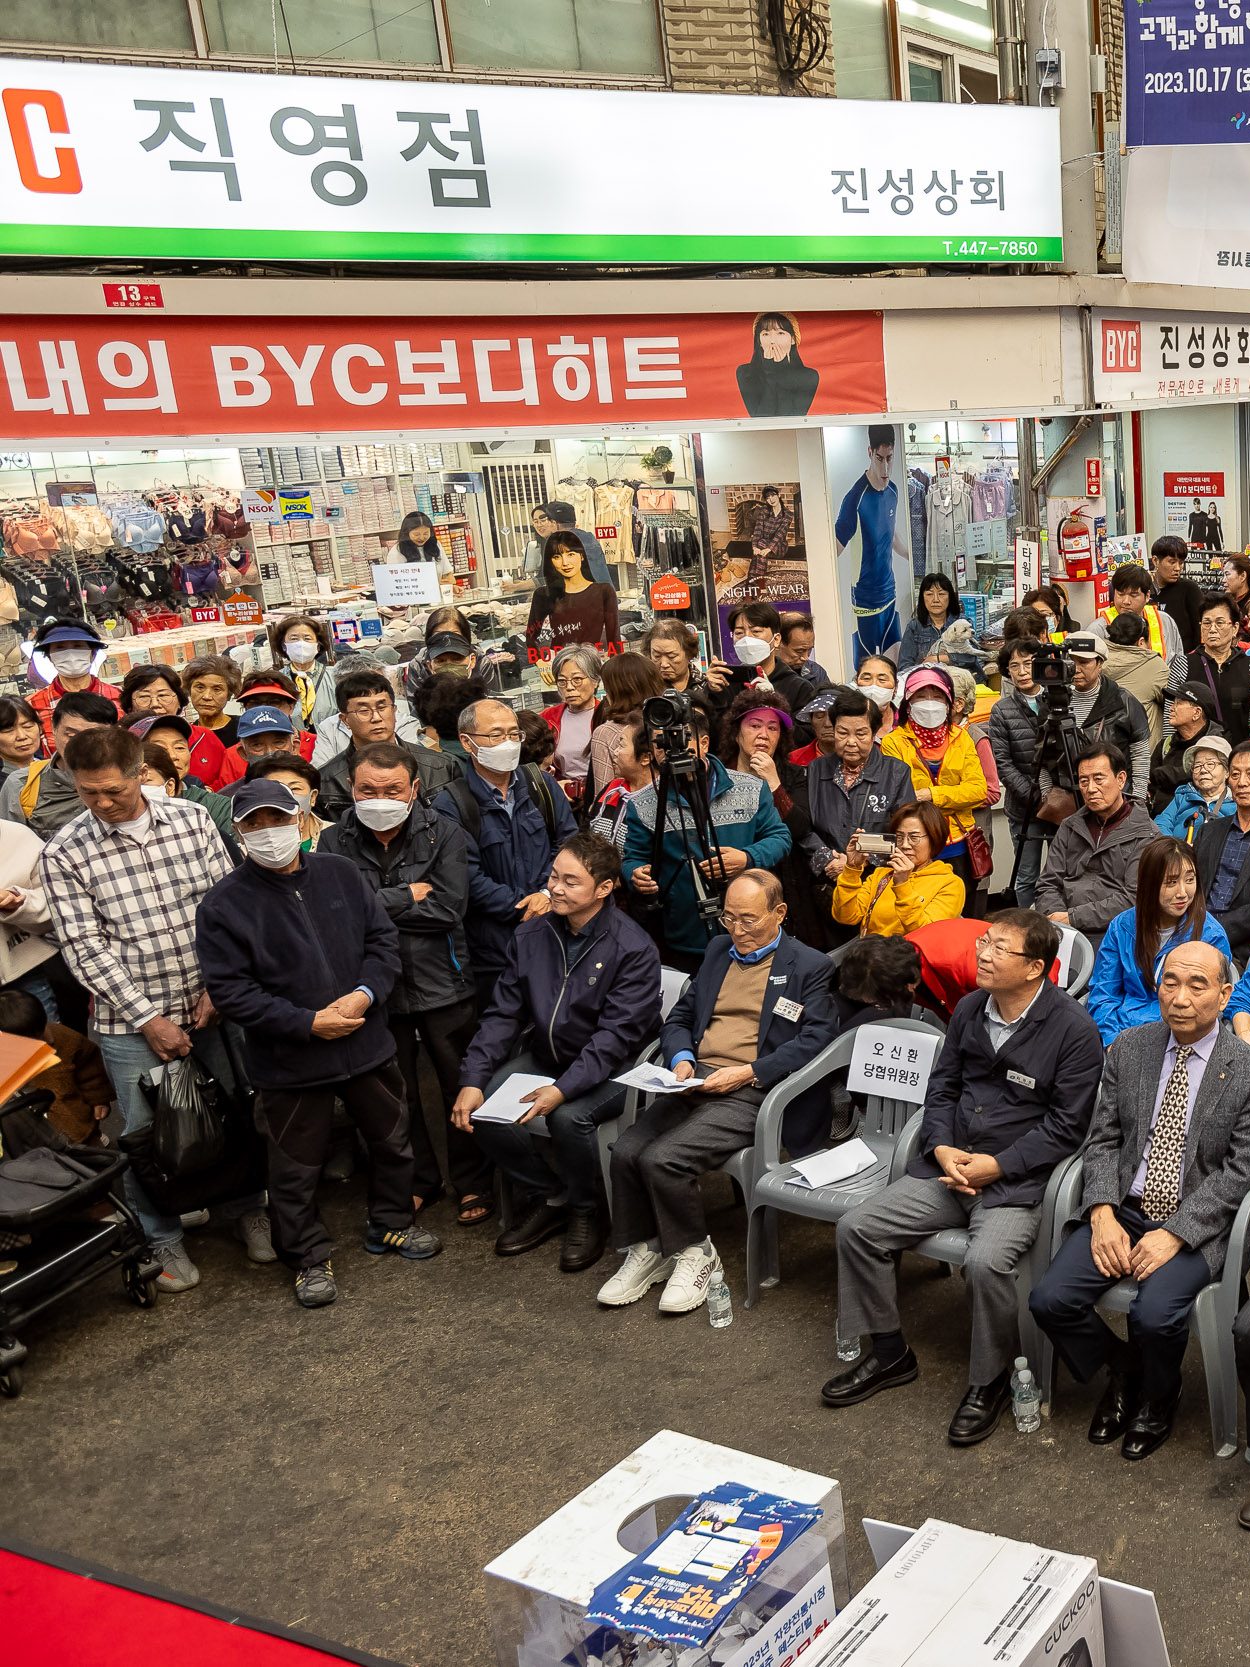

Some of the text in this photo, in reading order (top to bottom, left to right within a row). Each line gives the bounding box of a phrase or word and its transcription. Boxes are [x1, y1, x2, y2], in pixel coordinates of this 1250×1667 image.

[1139, 16, 1198, 51] 고객과
[1194, 11, 1244, 50] 함께
[1144, 66, 1232, 94] 2023.10.17
[134, 97, 492, 208] 직영점
[830, 167, 1006, 216] 진성상회
[942, 240, 1039, 258] T.447-7850
[118, 286, 141, 301] 13
[1106, 327, 1138, 369] BYC
[0, 334, 687, 416] 내의 BYC보디히트
[1158, 379, 1205, 399] 전문점으로
[1174, 486, 1187, 494] BYC
[248, 505, 274, 514] NSOK
[284, 504, 308, 512] NSOK
[598, 528, 614, 538] BYC
[654, 592, 688, 600] 온누리상품권
[722, 586, 760, 600] NIGHT
[196, 610, 216, 621] BYC
[873, 1042, 919, 1064] 오 신 환
[863, 1063, 920, 1087] 당협위원장
[678, 1584, 722, 1619] 맥주
[774, 1584, 826, 1644] 자양전통시장
[1044, 1579, 1096, 1655] CUCKOO
[778, 1614, 813, 1656] 페스티벌
